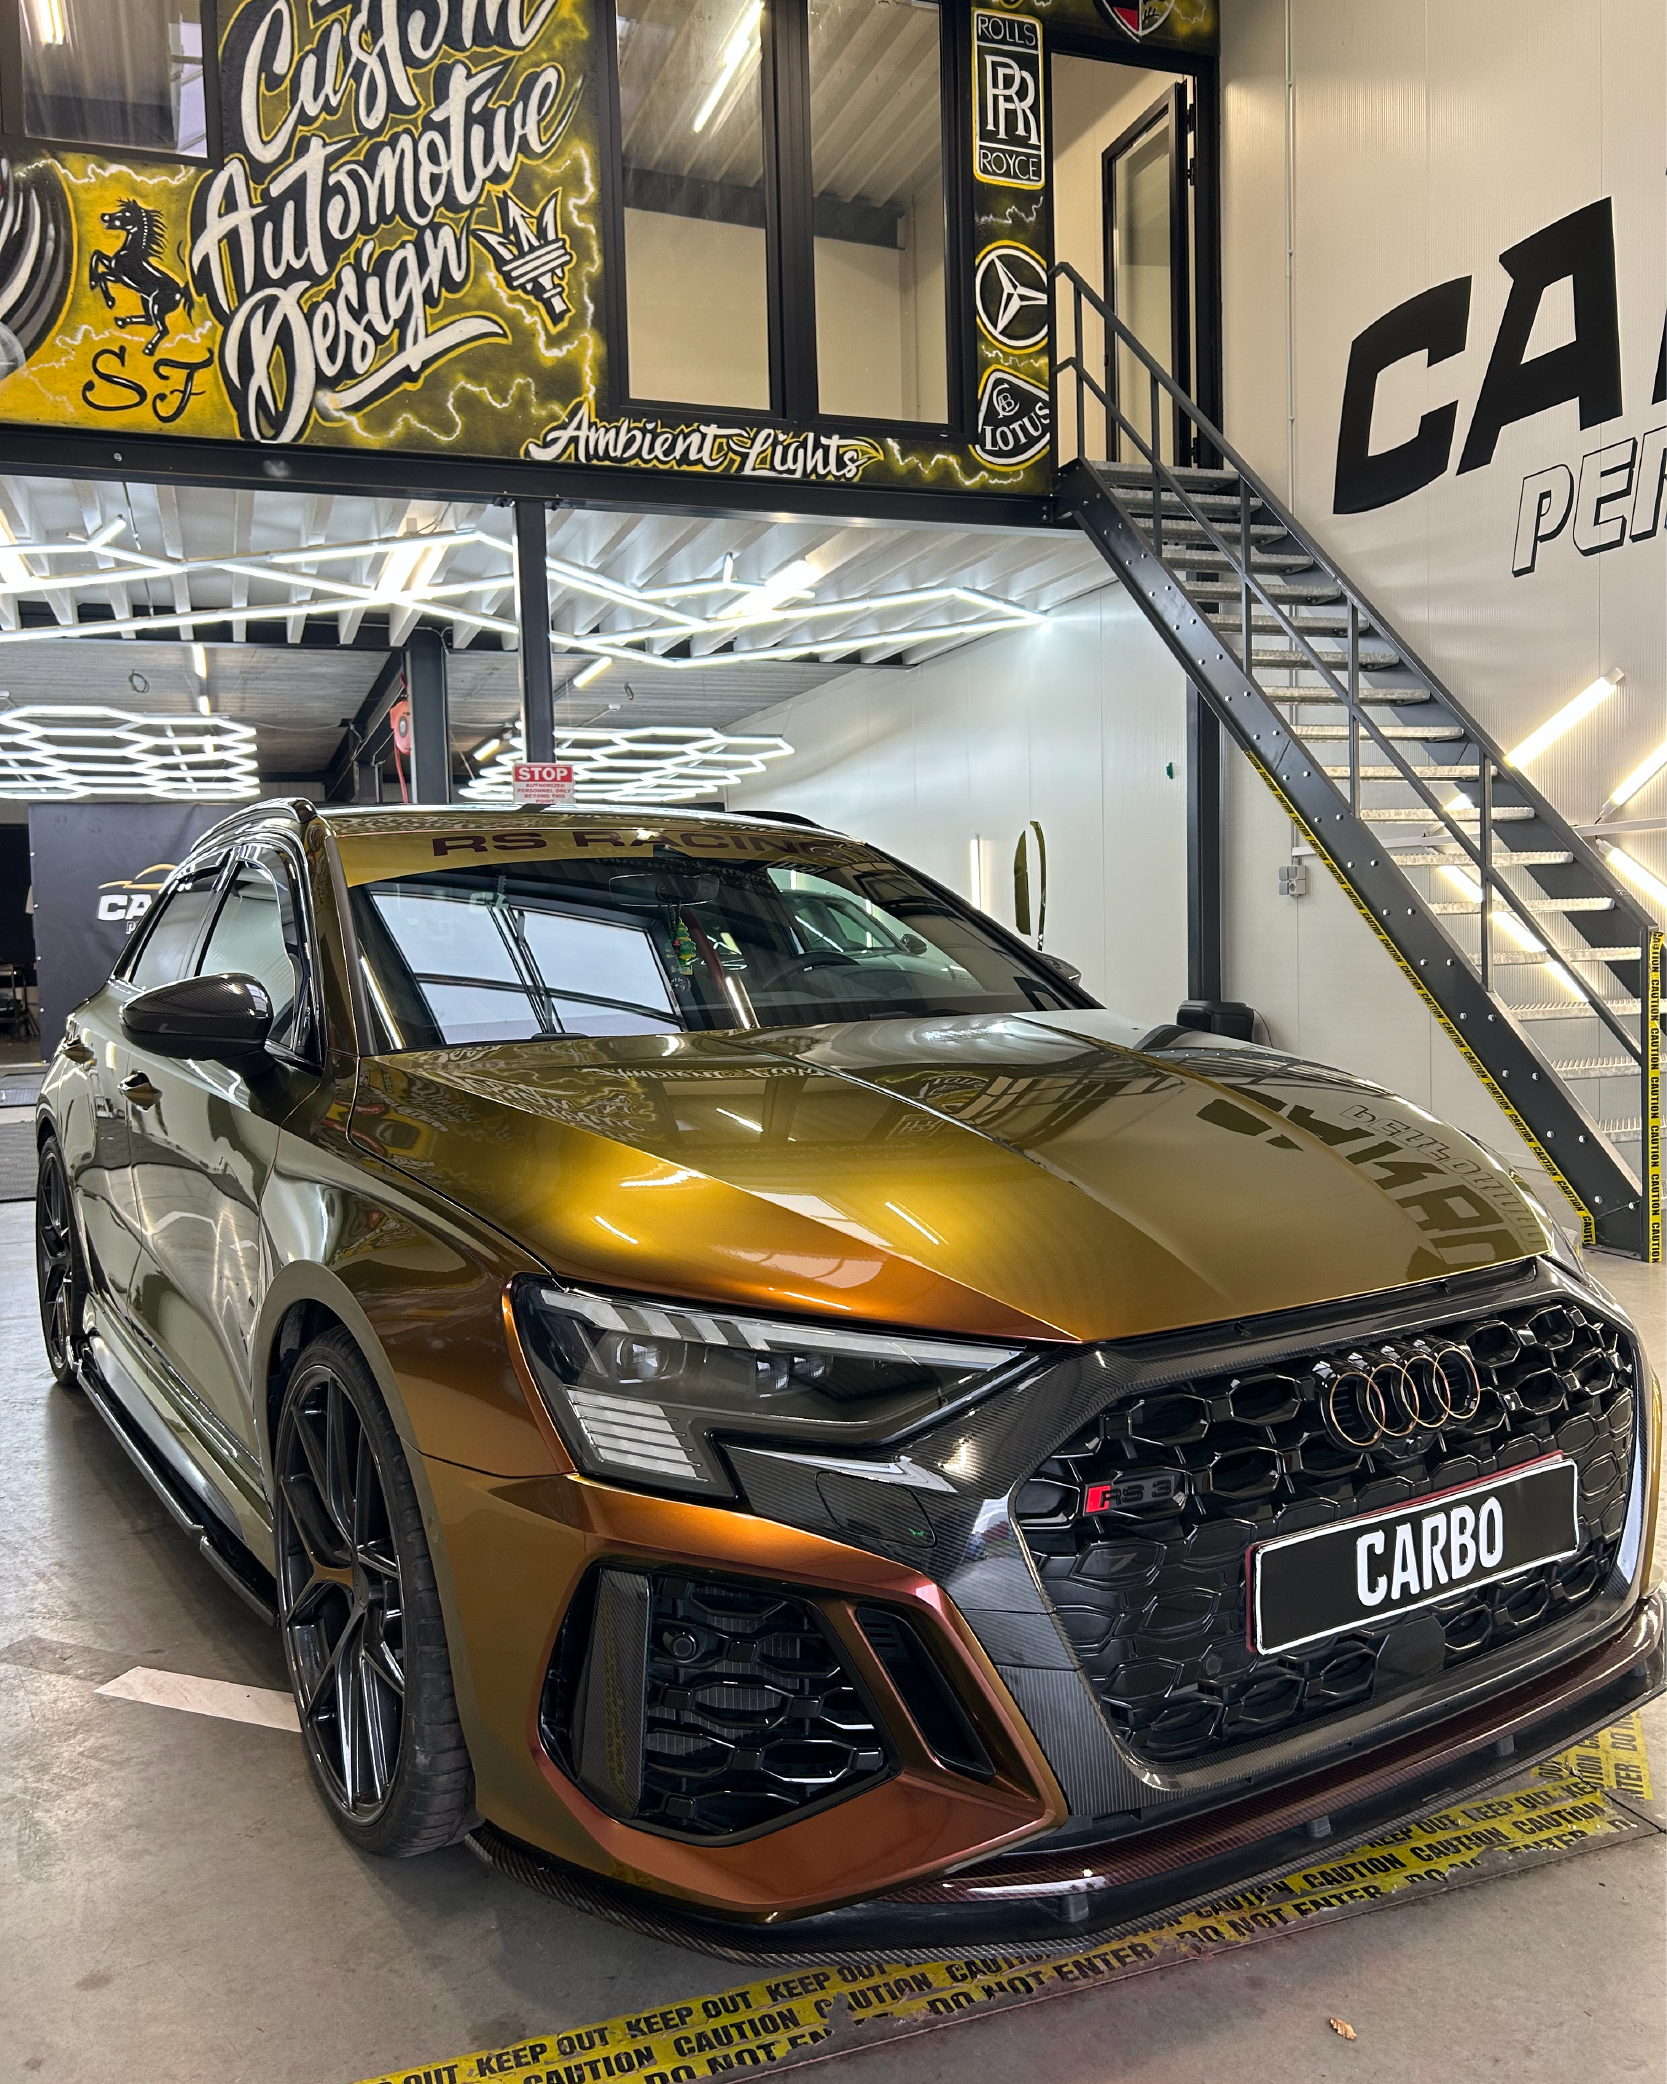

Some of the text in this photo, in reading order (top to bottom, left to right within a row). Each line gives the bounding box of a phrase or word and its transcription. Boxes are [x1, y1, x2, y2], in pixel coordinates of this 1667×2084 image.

[978, 16, 1036, 46] ROLLS
[979, 149, 1040, 180] ROYCE
[192, 63, 583, 313] Automotive
[224, 216, 510, 443] Design
[1333, 196, 1667, 515] CA
[528, 402, 884, 478] Ambient Lights
[983, 402, 1050, 451] LOTUS
[518, 767, 568, 781] STOP
[433, 833, 547, 857] RS
[1651, 931, 1663, 973] CAUTION
[1651, 979, 1660, 1021] CAUTION
[1326, 862, 1346, 885] CAUTION
[1344, 887, 1365, 910] CAUTION
[1362, 912, 1384, 936] CAUTION
[1381, 938, 1403, 962] CAUTION
[1400, 965, 1424, 991] CAUTION
[1421, 993, 1445, 1019] CAUTION
[1442, 1022, 1467, 1048] CAUTION
[1464, 1051, 1489, 1079] CAUTION
[1486, 1082, 1511, 1110] CAUTION
[1508, 1113, 1535, 1143] CAUTION
[1533, 1146, 1560, 1177] CAUTION
[1556, 1180, 1585, 1212] CAUTION
[1651, 1027, 1660, 1070] CAUTION
[1651, 1077, 1660, 1119] CAUTION
[1651, 1126, 1660, 1167] CAUTION
[1651, 1174, 1660, 1216] CAUTION
[1100, 1479, 1172, 1508] RS 3
[1357, 1497, 1503, 1606] CARBO
[1516, 1790, 1554, 1810] OUT
[1302, 1853, 1406, 1889] CAUTION
[1409, 1826, 1508, 1863] CAUTION
[1513, 1801, 1606, 1835] CAUTION
[1052, 1942, 1154, 1983] ENTER
[1226, 1907, 1289, 1938] NOT
[476, 2043, 547, 2078] KEEP
[556, 2027, 609, 2056] OUT
[625, 2006, 694, 2038] KEEP
[701, 1991, 753, 2019] OUT
[765, 1973, 831, 2002] KEEP
[673, 2008, 800, 2058] CAUTION
